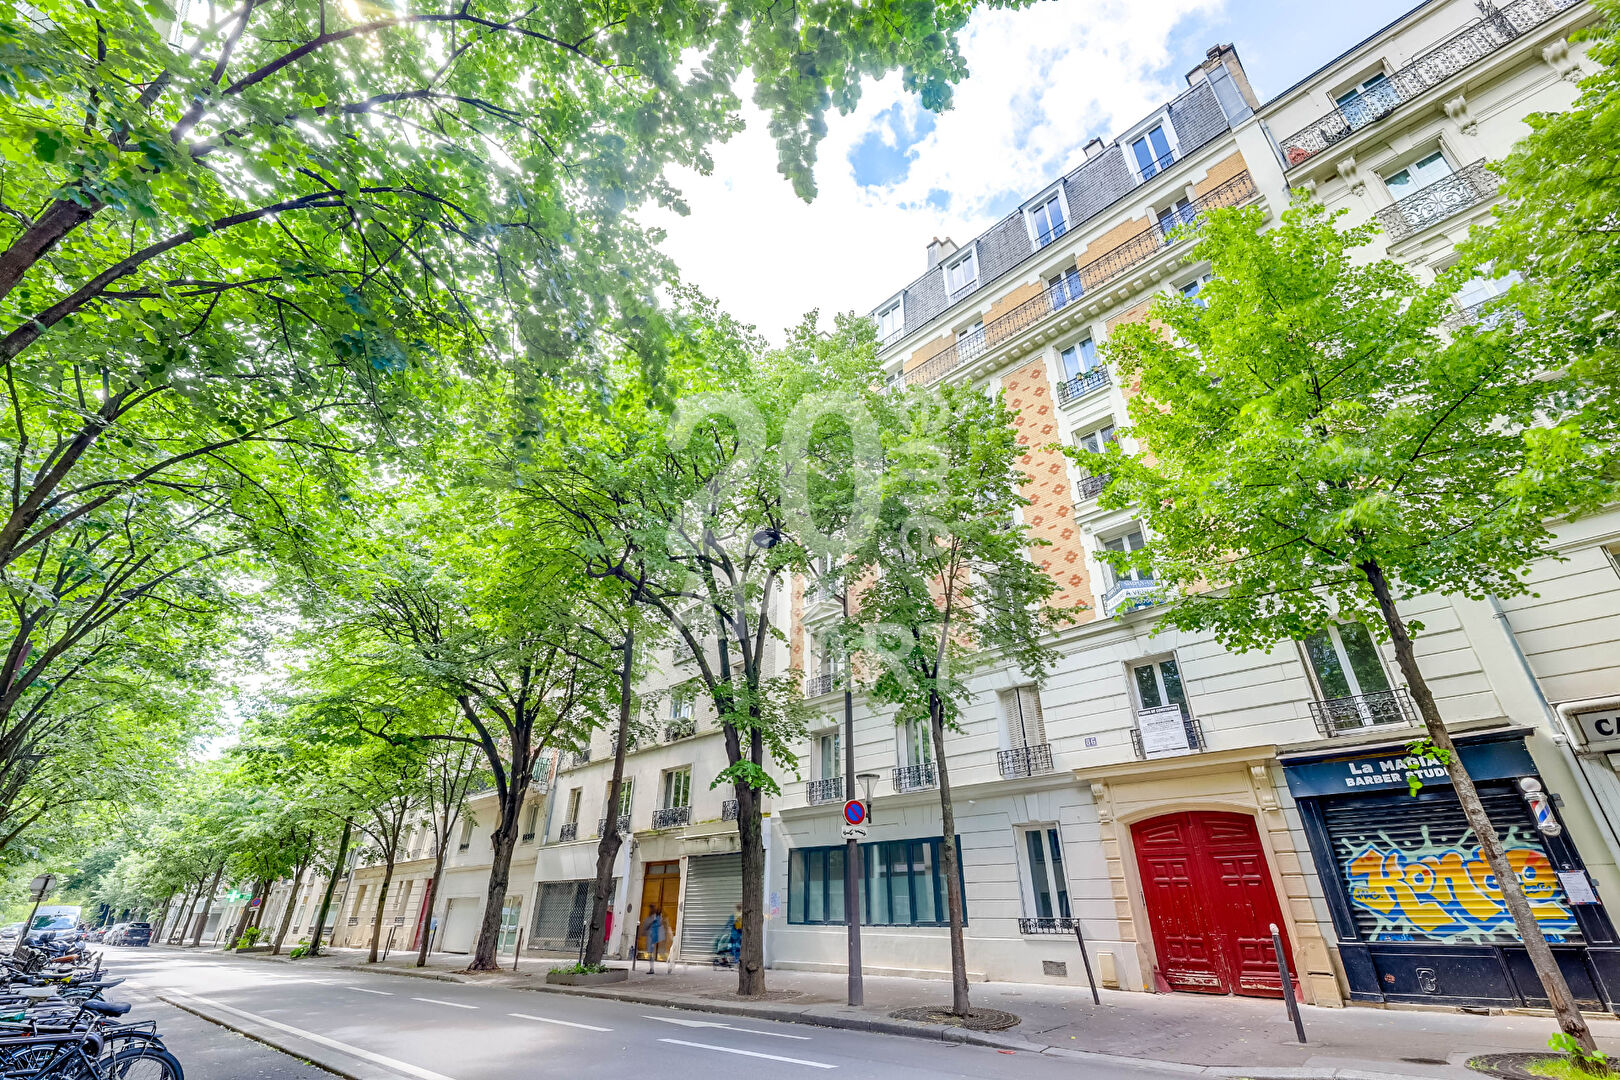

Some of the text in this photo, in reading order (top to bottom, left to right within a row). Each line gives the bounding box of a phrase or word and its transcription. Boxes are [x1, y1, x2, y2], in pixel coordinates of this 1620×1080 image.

[1594, 716, 1620, 736] C
[1345, 766, 1449, 787] BARBER STUDI
[1348, 762, 1374, 775] La
